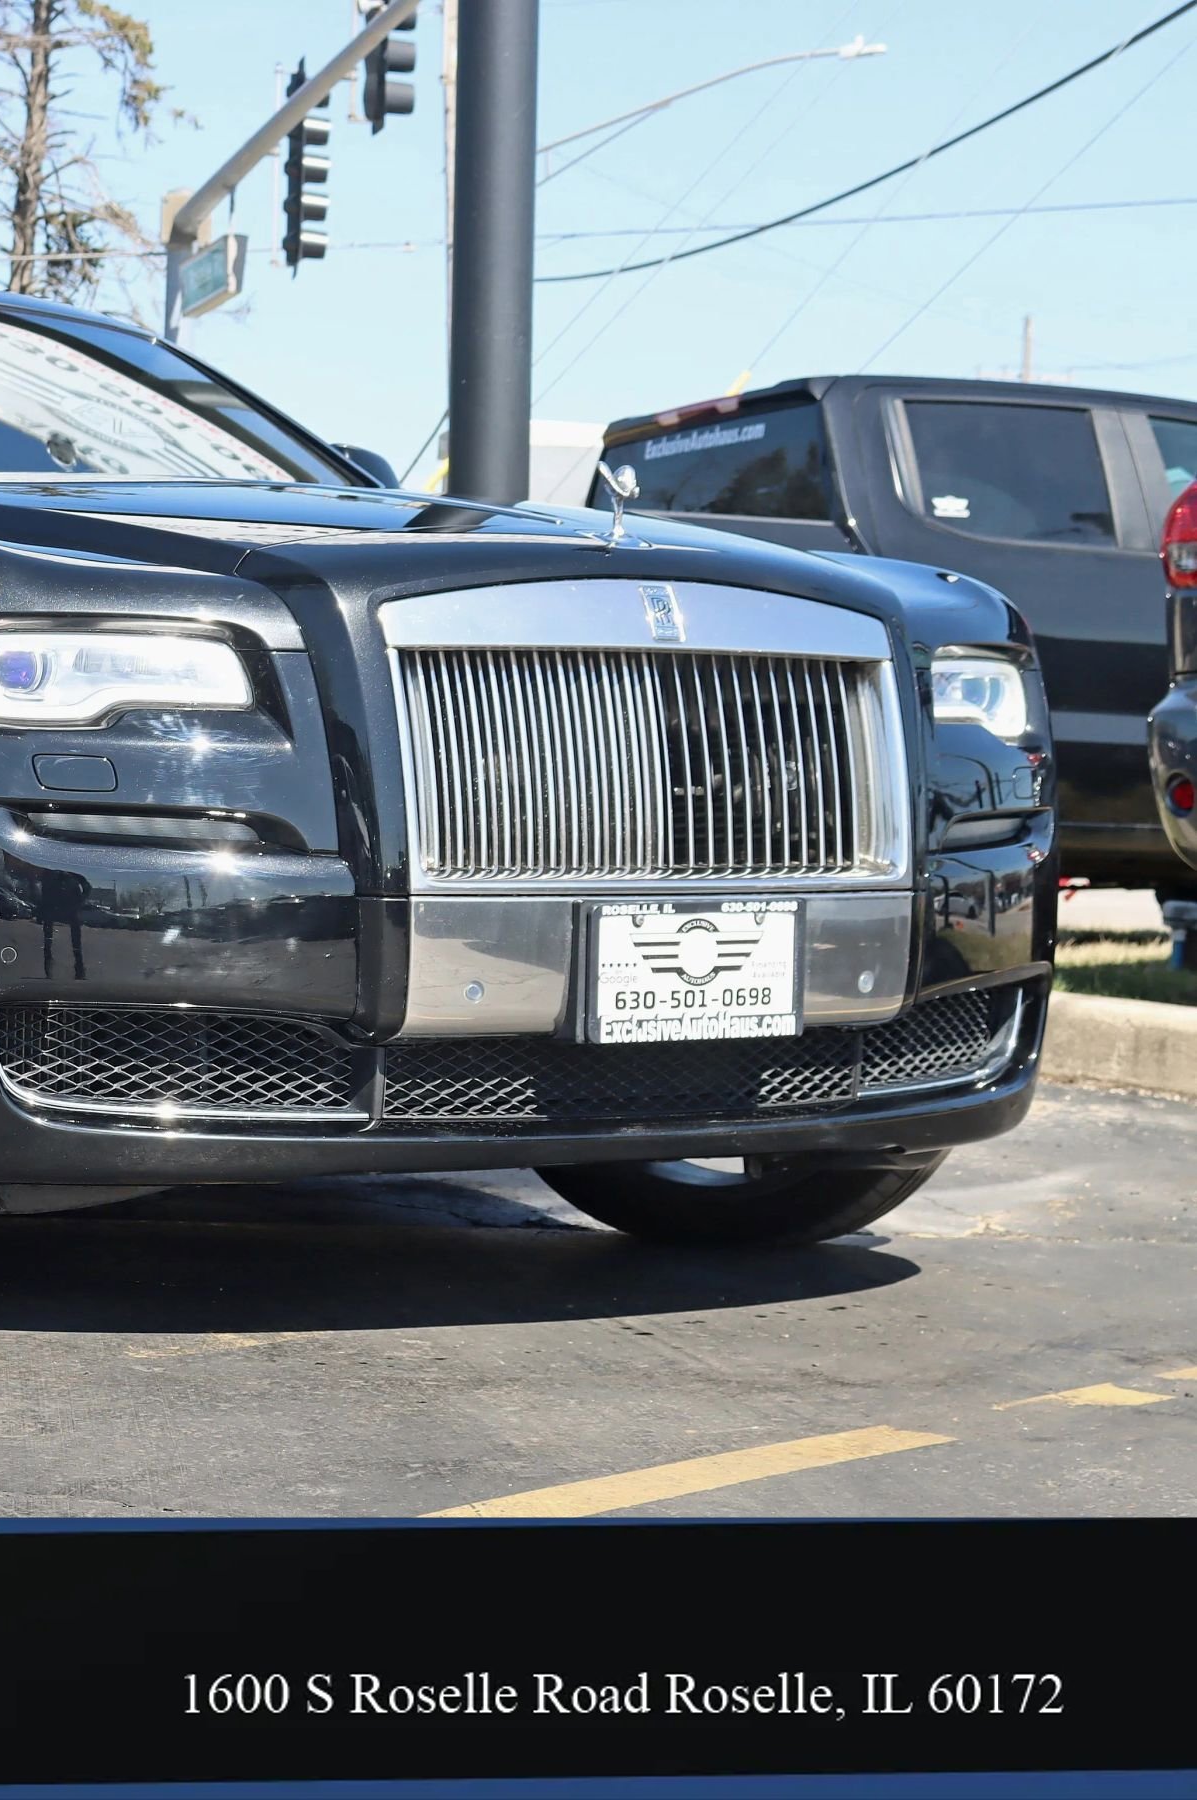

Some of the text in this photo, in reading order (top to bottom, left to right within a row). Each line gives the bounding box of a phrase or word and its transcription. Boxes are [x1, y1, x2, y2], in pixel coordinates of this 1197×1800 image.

[602, 904, 676, 916] ROSELLE, IL
[721, 901, 798, 913] 630-501-0698
[615, 987, 772, 1010] 630-501-0698
[600, 1012, 796, 1044] ExclusiveAutoHaus.com
